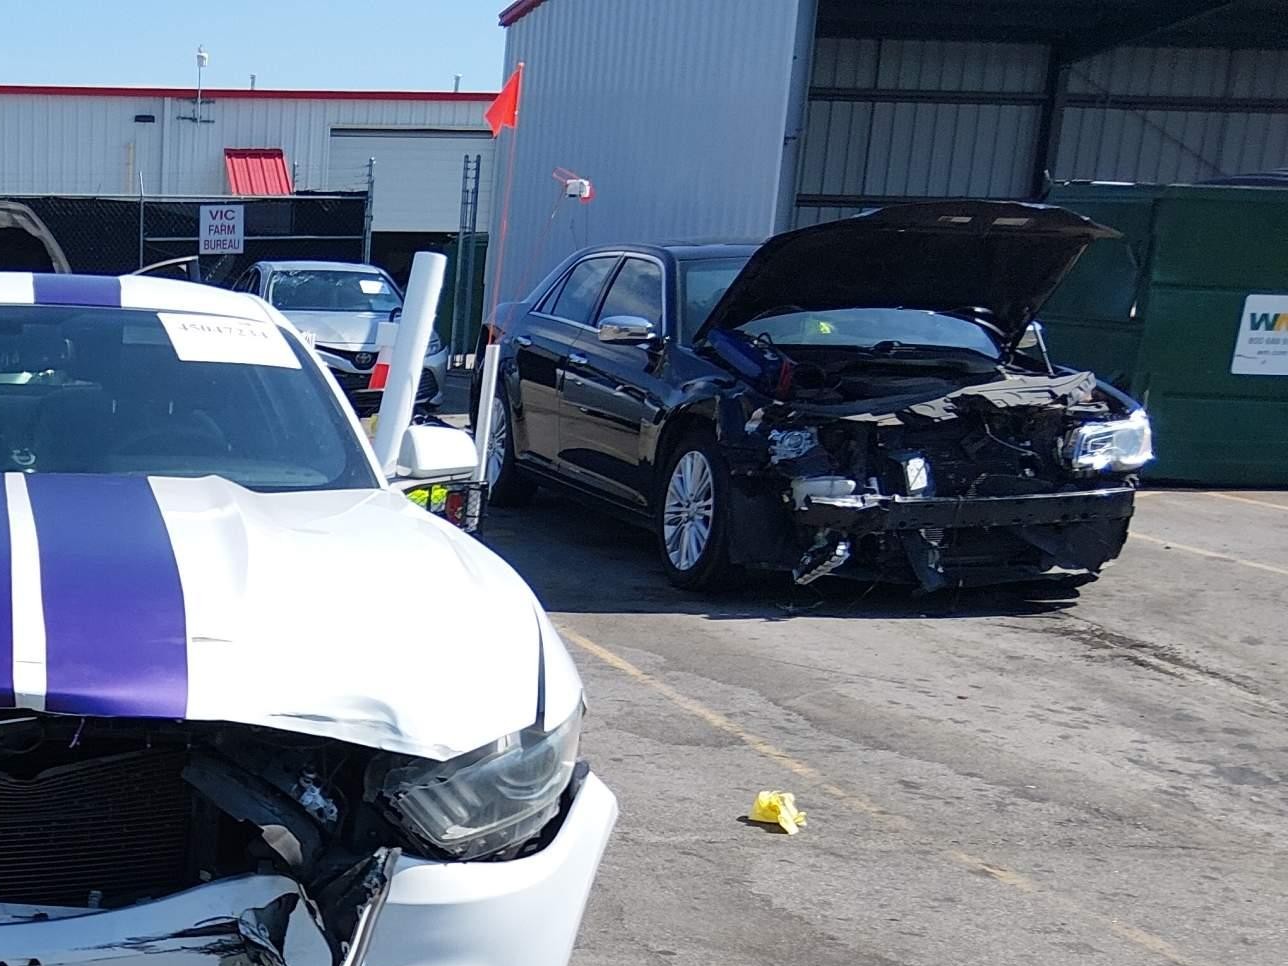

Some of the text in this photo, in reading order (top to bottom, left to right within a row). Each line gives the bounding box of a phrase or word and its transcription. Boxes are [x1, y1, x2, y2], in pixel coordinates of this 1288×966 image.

[209, 209, 236, 221] VIC
[208, 224, 236, 235] FARM
[203, 239, 240, 250] BUREAU
